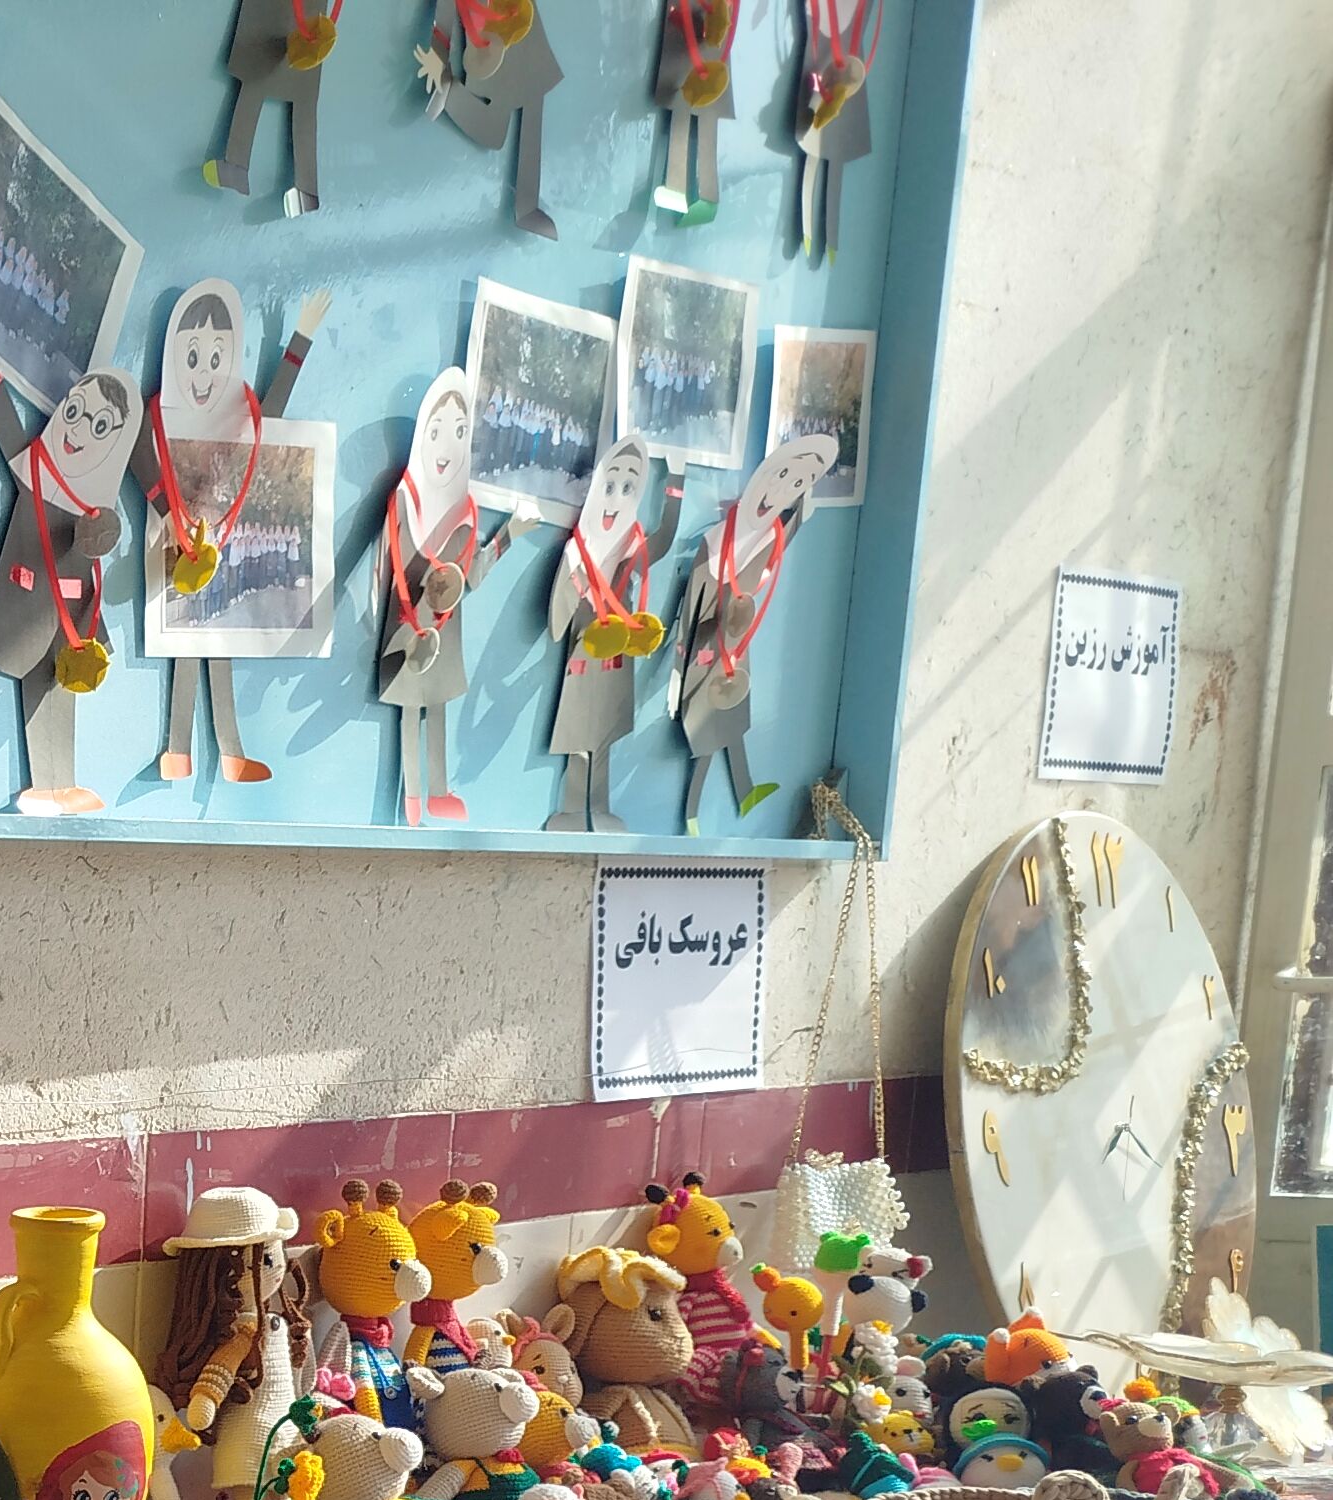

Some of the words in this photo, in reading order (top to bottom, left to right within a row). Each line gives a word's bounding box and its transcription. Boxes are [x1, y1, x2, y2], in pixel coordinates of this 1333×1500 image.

[1065, 628, 1106, 670] رزین
[1111, 625, 1169, 675] آموزش
[615, 910, 662, 968] بافی
[669, 914, 748, 966] عروسک
